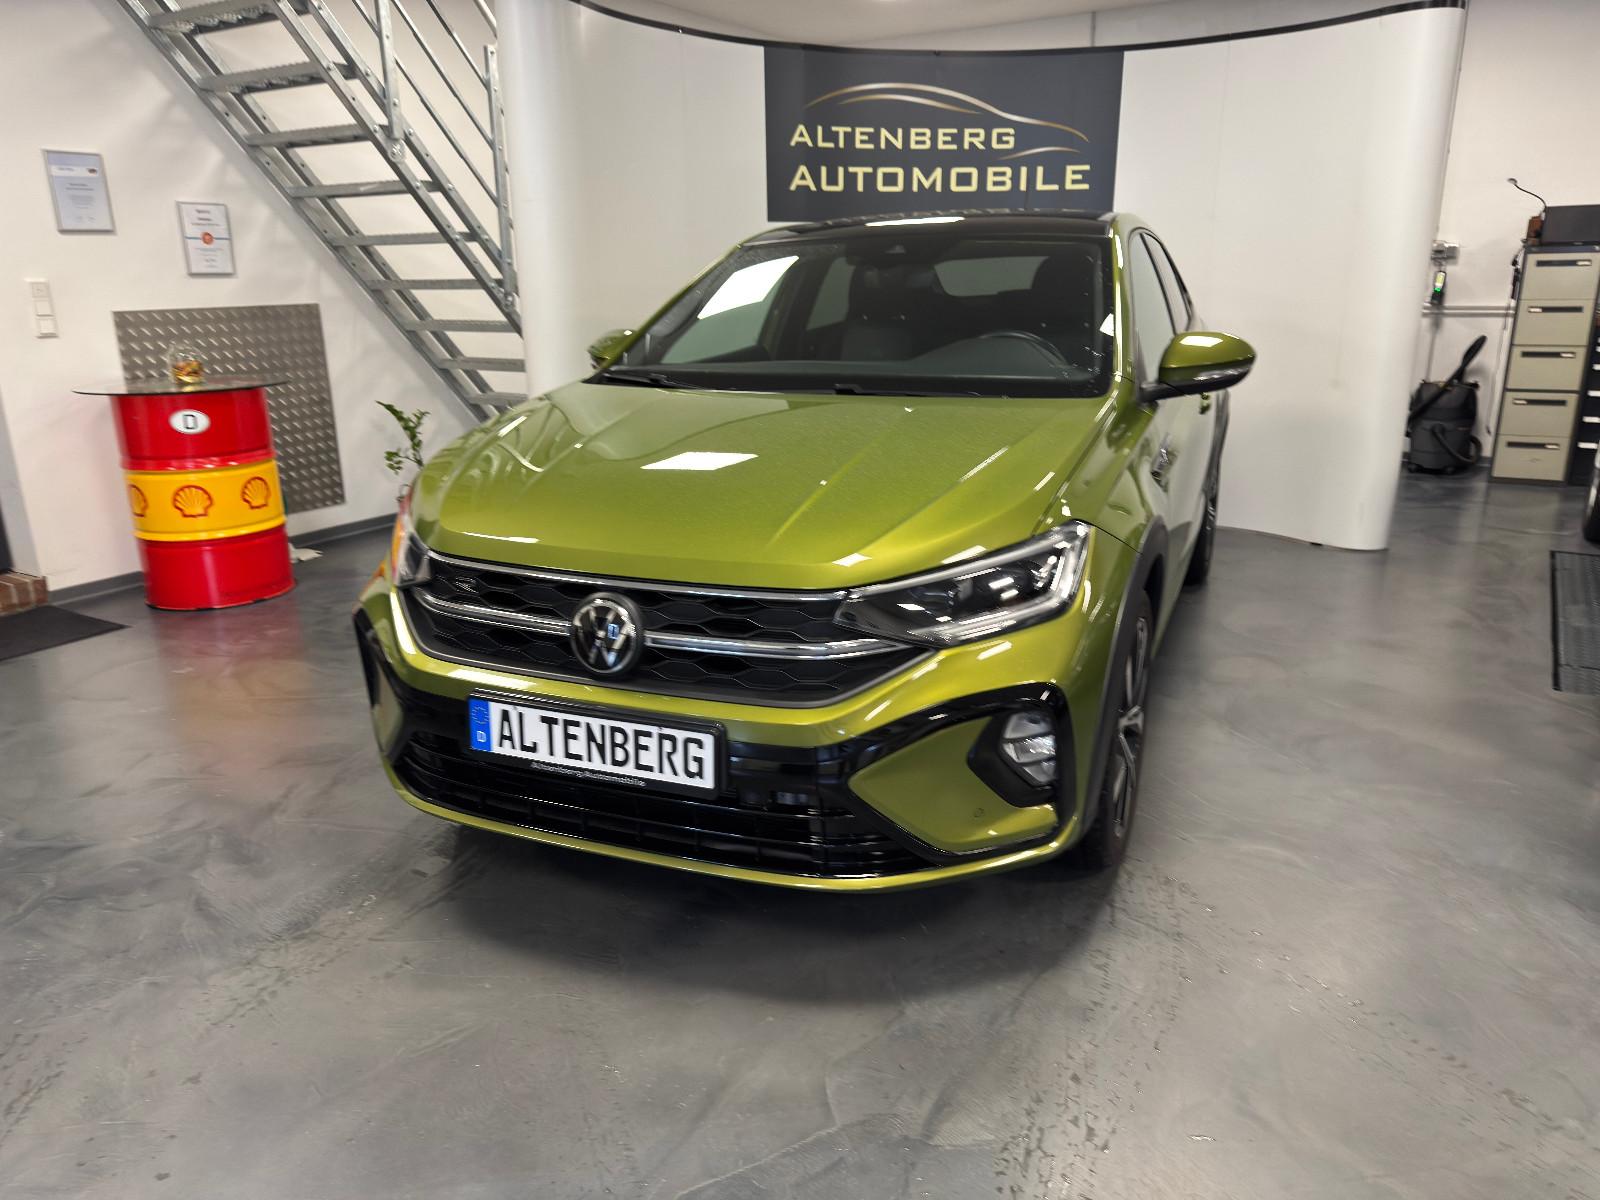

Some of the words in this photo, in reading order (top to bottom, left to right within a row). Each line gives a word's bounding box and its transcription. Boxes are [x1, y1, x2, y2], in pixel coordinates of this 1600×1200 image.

[789, 124, 1016, 151] ALTENBERG
[789, 164, 1091, 193] AUTOMOBILE
[183, 414, 197, 430] D
[476, 730, 487, 742] D
[498, 709, 704, 780] ALTENBERG
